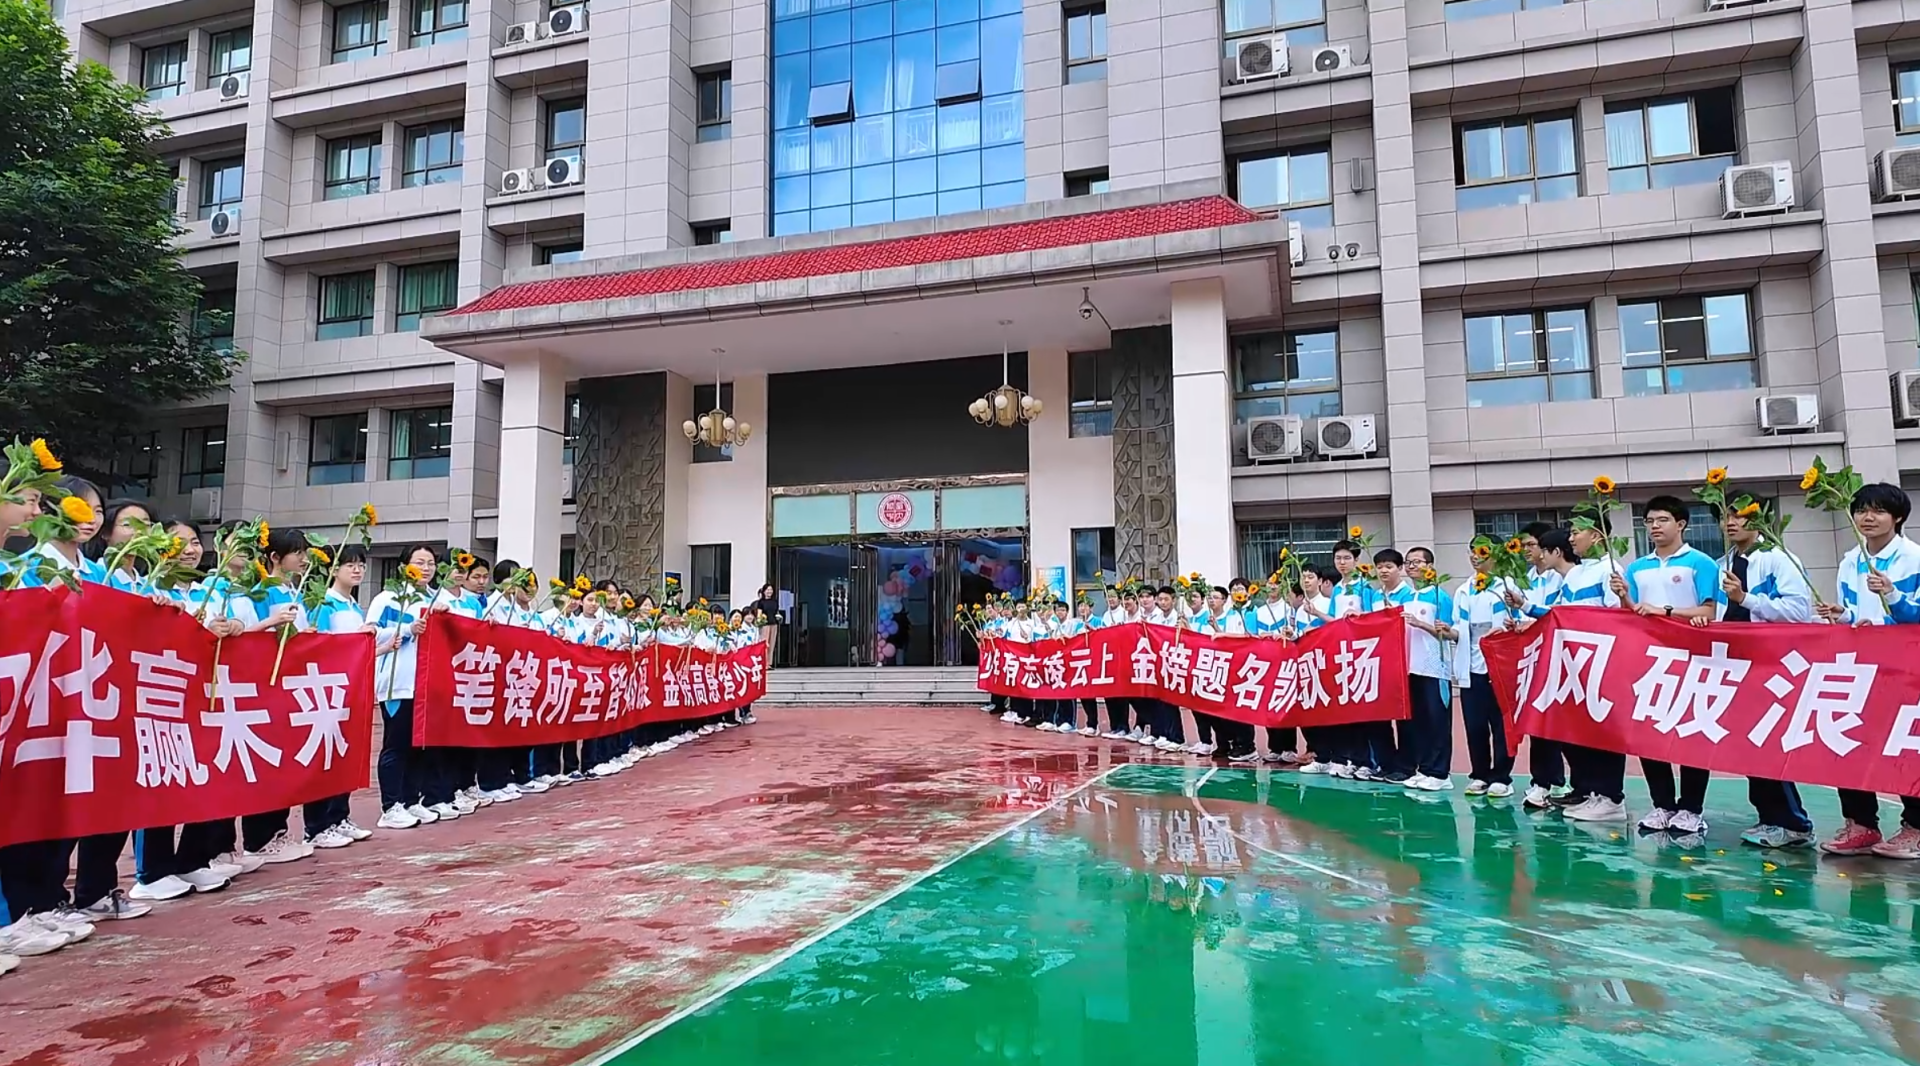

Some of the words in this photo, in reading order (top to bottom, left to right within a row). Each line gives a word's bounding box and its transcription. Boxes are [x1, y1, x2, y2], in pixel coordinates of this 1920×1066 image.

[1130, 637, 1381, 713] 金榜题名凯歌扬
